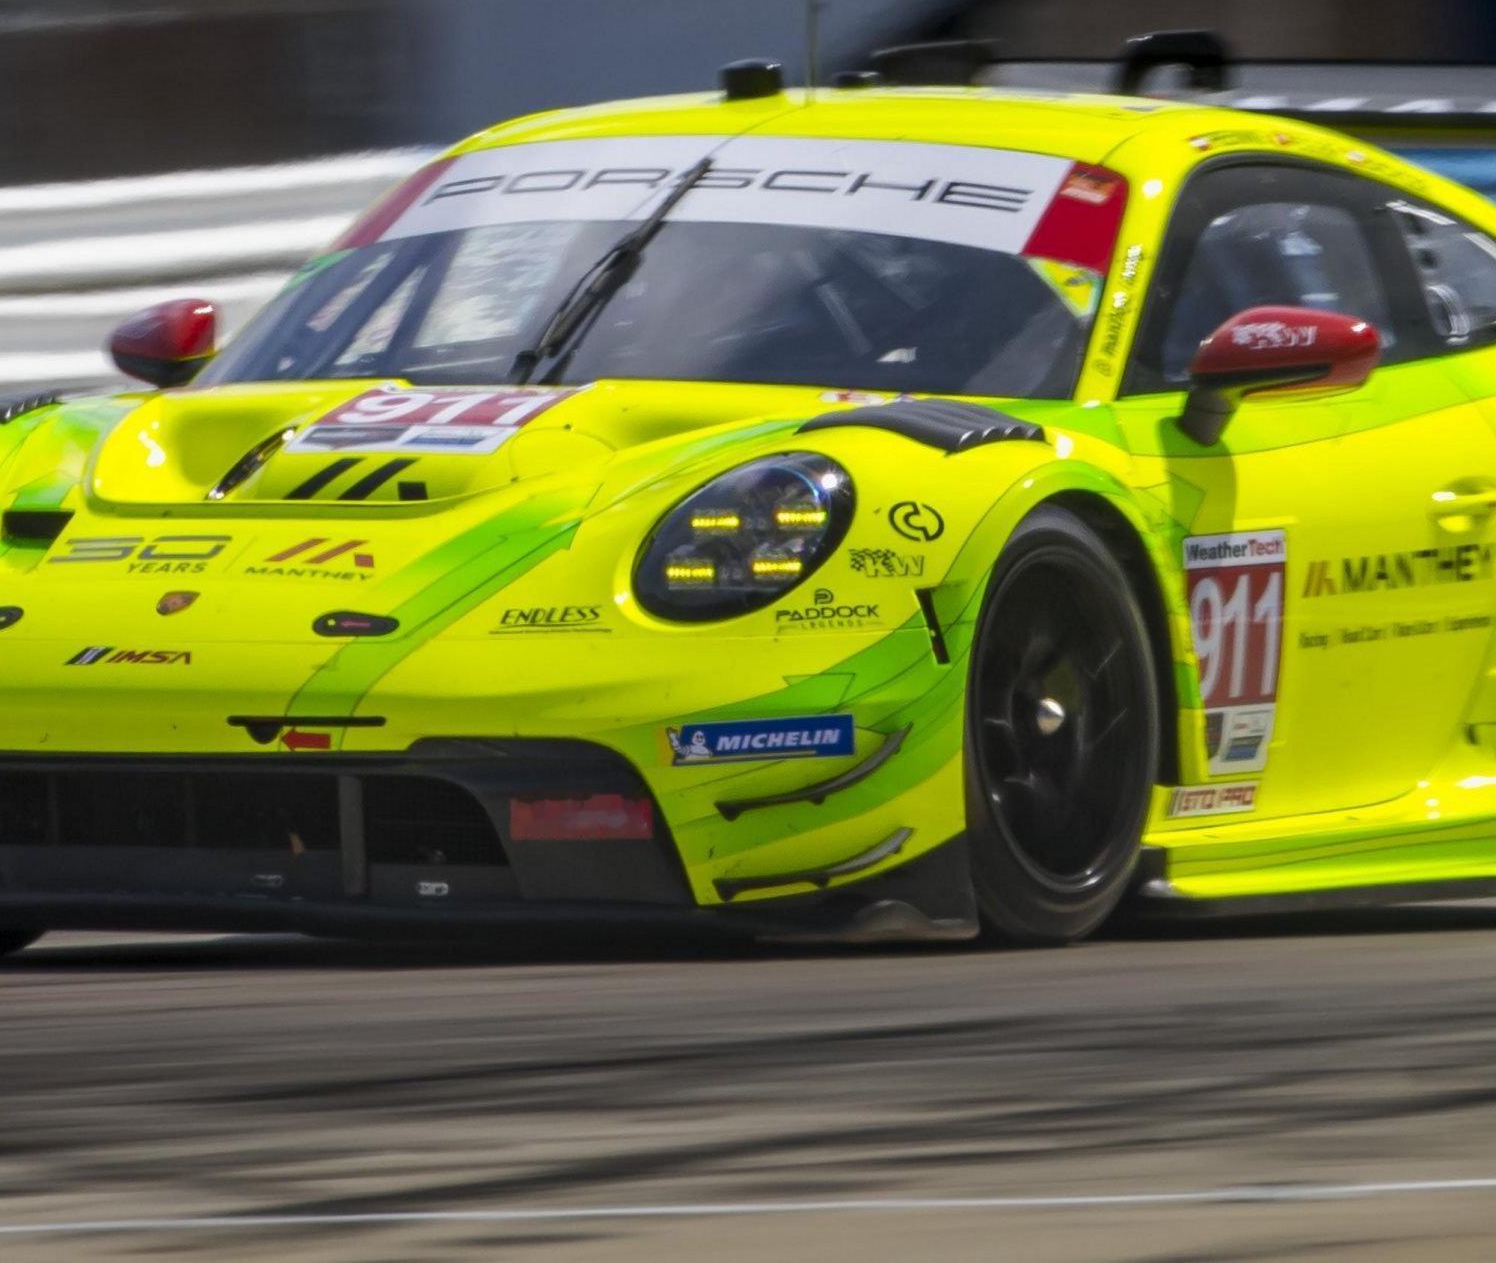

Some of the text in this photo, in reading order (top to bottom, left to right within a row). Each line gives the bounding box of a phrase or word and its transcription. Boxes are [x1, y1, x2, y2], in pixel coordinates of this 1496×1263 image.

[421, 166, 1037, 213] PORSCHE
[337, 391, 562, 425] 911
[1186, 538, 1283, 562] WeatherTech
[126, 561, 208, 574] YEARS
[244, 566, 374, 582] MANTHEY
[863, 553, 925, 578] KW
[1341, 543, 1494, 593] MANTHEY
[500, 604, 604, 626] ENDLESS
[776, 604, 880, 623] PADDOCK
[1190, 571, 1284, 702] 911
[106, 649, 193, 666] IMSA
[715, 728, 842, 752] MICHELIN
